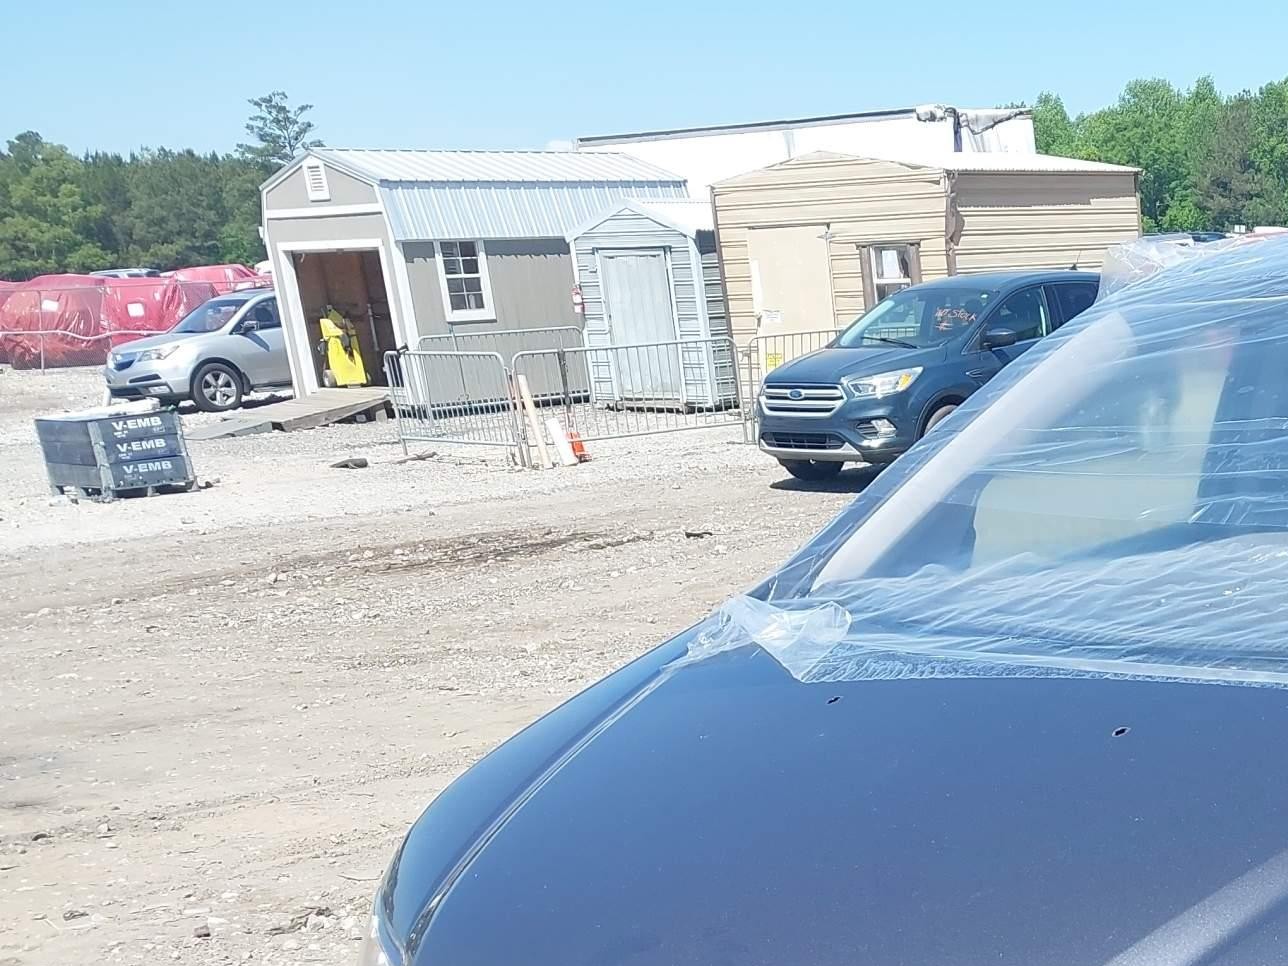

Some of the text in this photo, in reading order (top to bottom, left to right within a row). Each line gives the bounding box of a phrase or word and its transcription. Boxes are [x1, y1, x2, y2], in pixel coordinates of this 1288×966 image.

[112, 416, 162, 431] V-EMB
[116, 439, 166, 453] V-EMB
[123, 461, 172, 474] V-EMB
